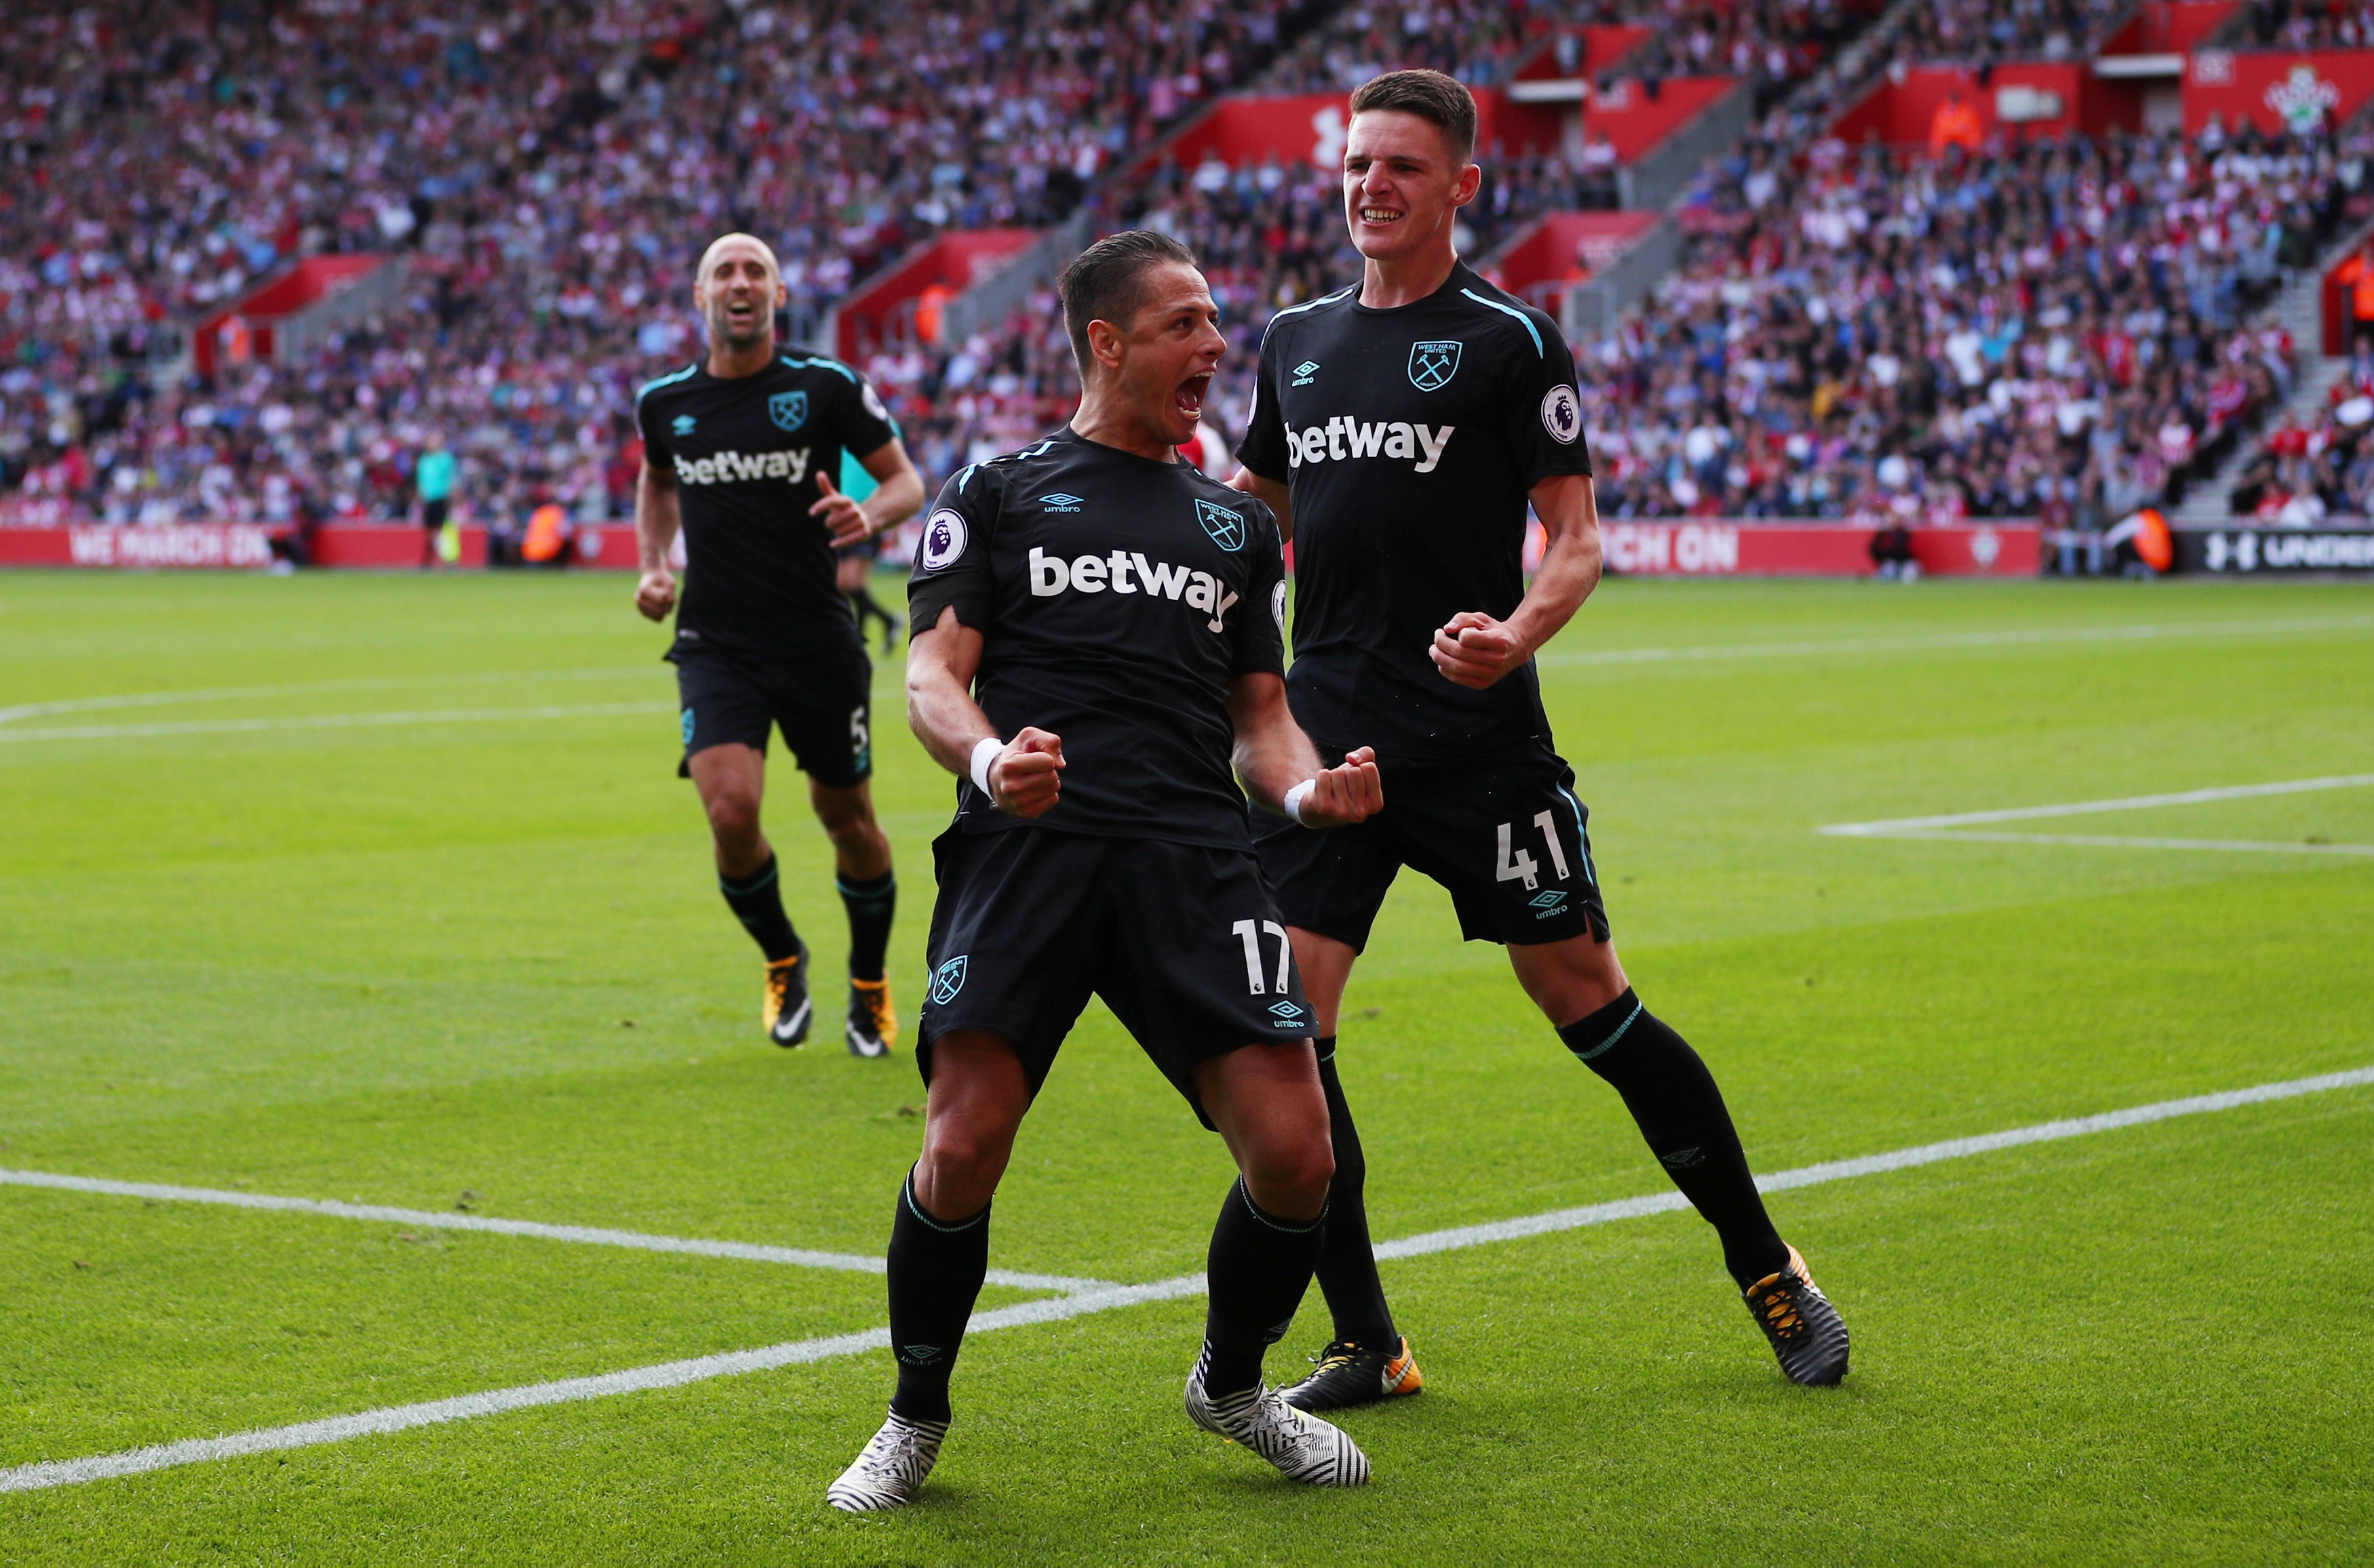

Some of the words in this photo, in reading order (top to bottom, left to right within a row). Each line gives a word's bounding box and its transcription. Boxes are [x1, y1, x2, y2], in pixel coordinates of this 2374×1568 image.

[1291, 376, 1314, 387] umbro
[674, 447, 810, 484] betway
[1285, 415, 1455, 473] betway
[69, 524, 113, 565] WE
[1676, 524, 1738, 571] ON
[1029, 547, 1239, 633] betway
[851, 705, 868, 755] 5
[1496, 810, 1570, 890] 41
[1536, 905, 1568, 919] umbro
[1232, 919, 1289, 995] 17
[1274, 1019, 1304, 1027] umbro
